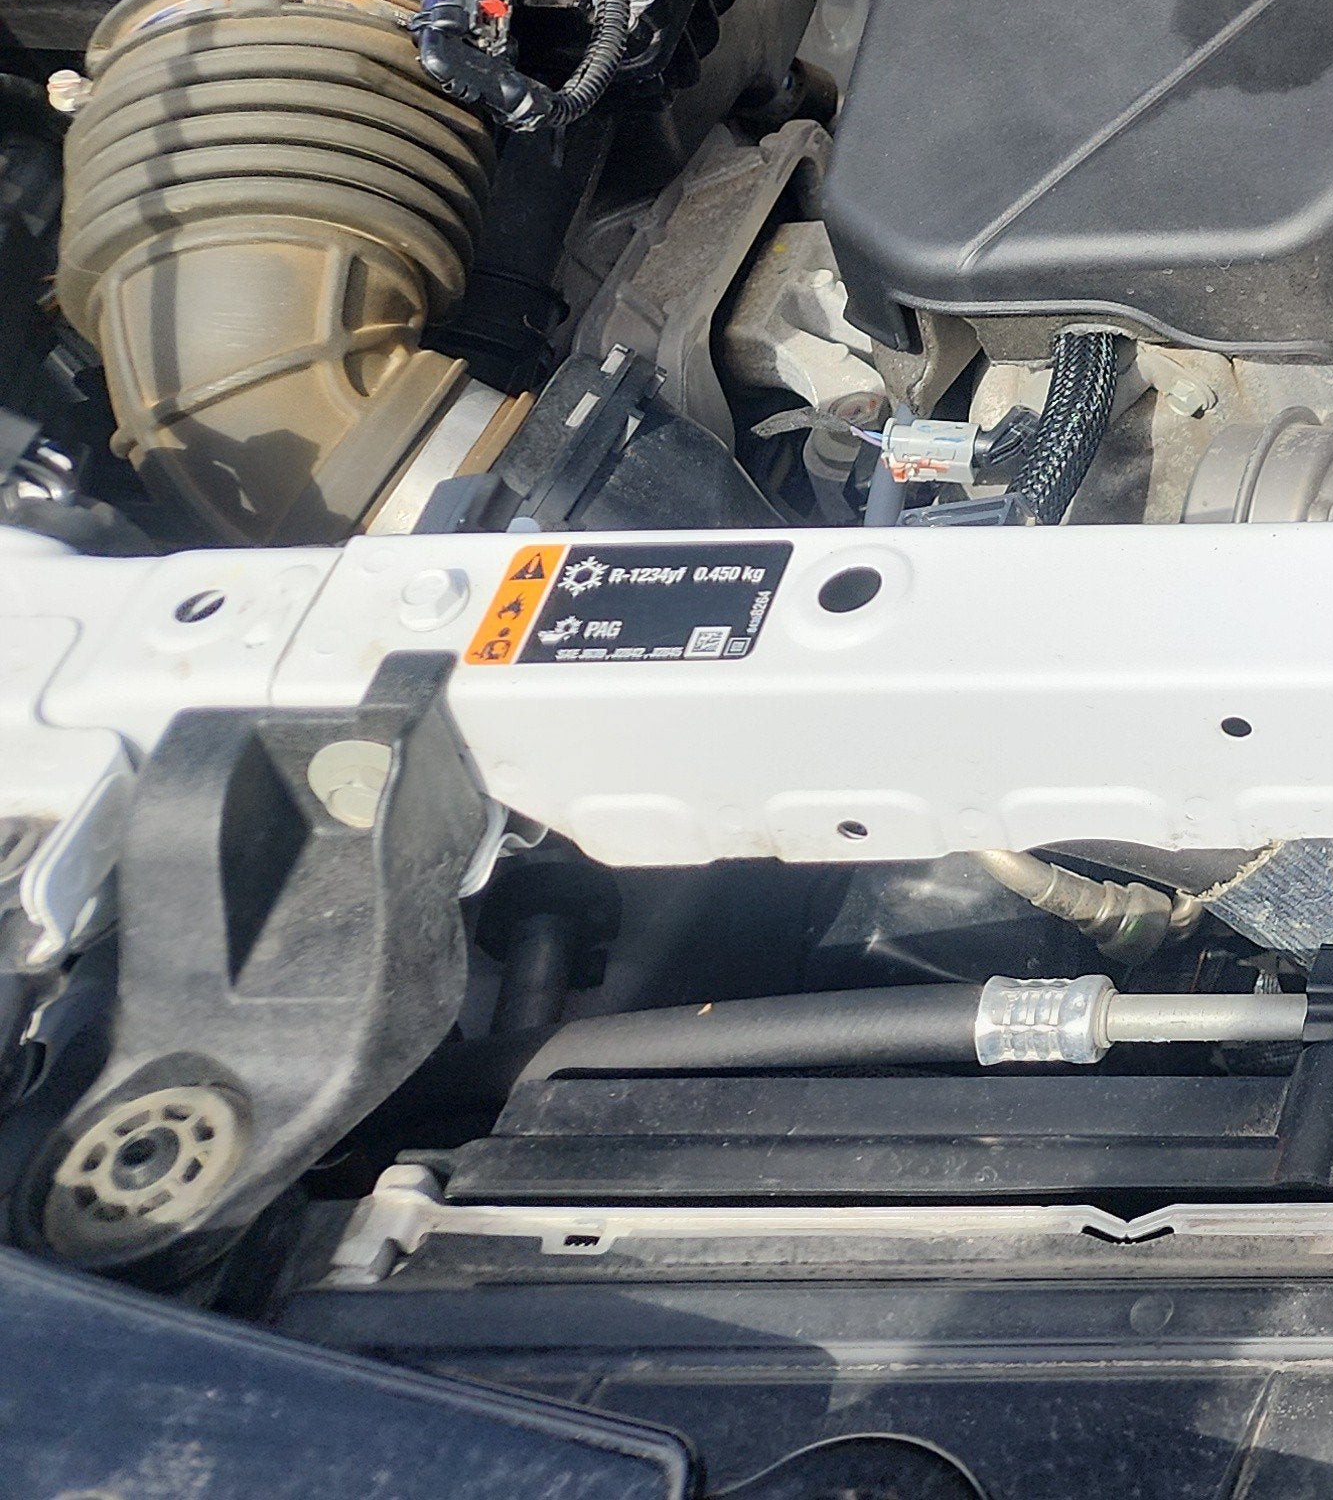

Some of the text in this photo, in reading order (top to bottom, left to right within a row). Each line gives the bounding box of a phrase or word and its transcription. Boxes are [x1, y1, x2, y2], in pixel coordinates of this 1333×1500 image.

[608, 566, 766, 585] R-1234yf 0.450 kg
[583, 620, 623, 639] PAG
